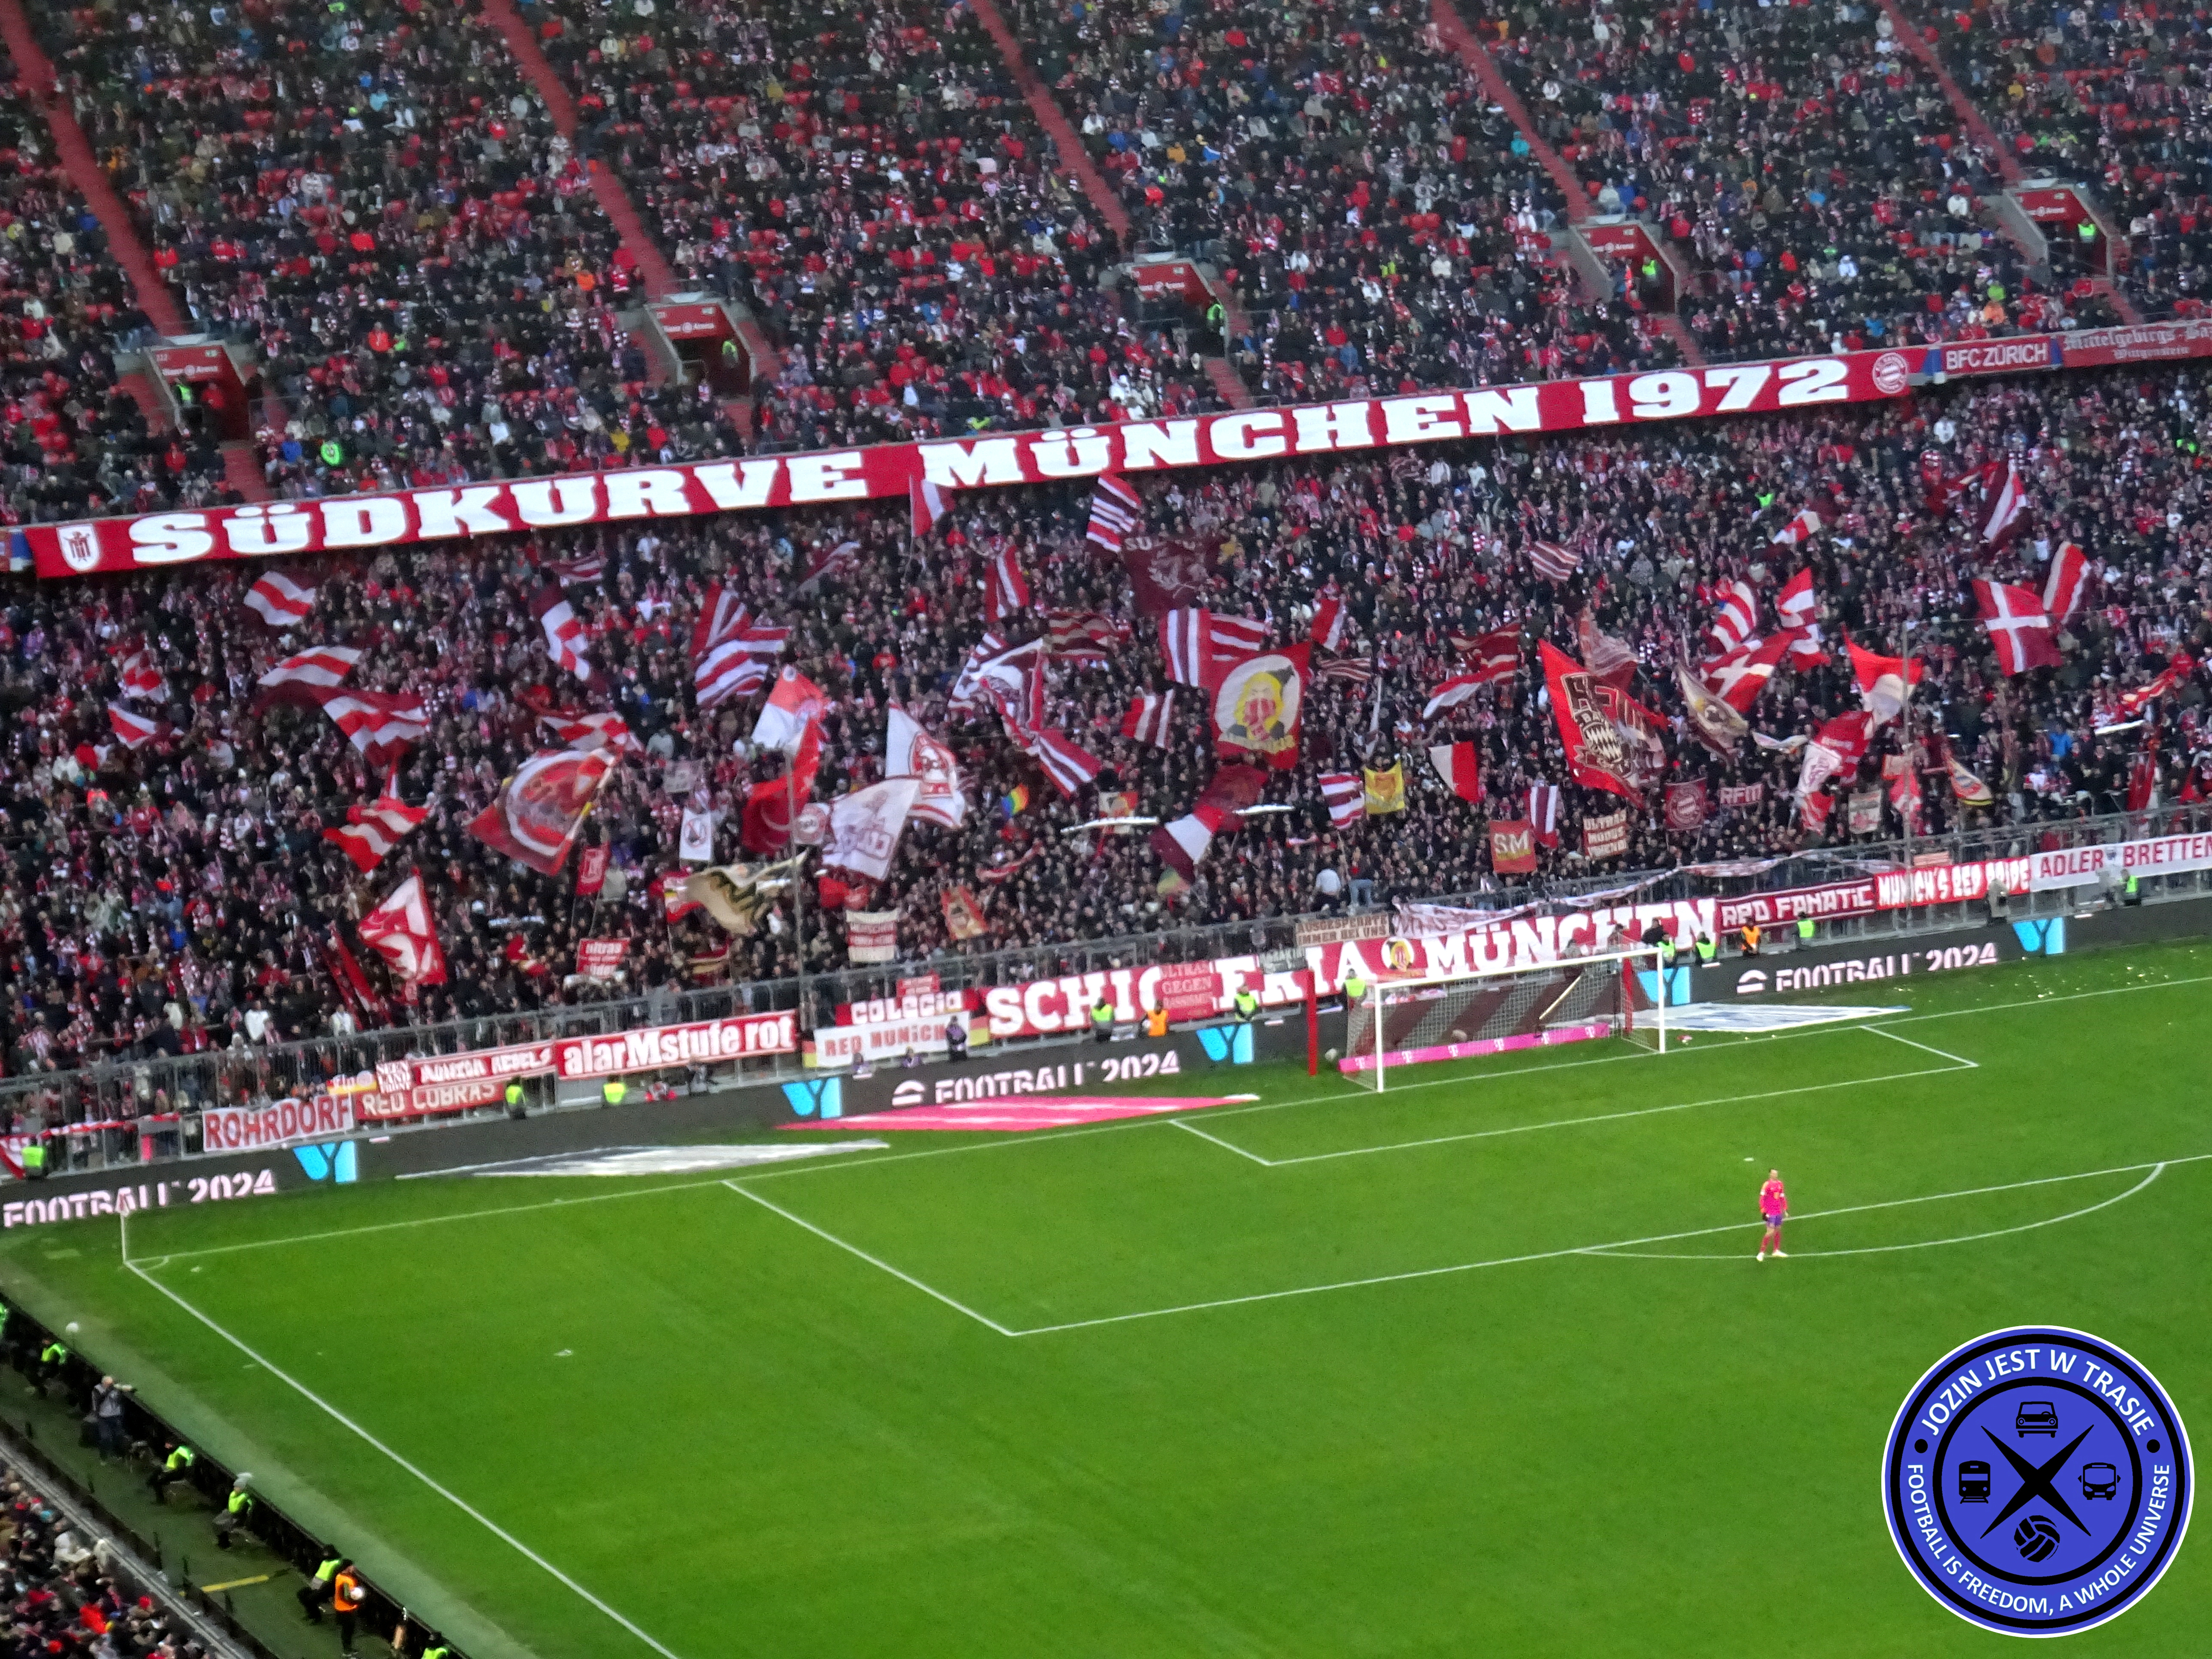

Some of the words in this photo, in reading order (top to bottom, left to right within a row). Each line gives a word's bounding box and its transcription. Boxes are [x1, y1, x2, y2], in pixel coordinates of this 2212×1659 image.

[1946, 348, 1981, 370] BFC
[1983, 342, 2048, 366] ZÜRICH
[129, 451, 868, 563] SÜDKURVE
[919, 386, 1542, 487] MÜNCHEN
[1580, 359, 1849, 424] 1972
[1494, 829, 1529, 854] SM
[2040, 850, 2104, 878] ADLER
[1926, 942, 1997, 972] 2024
[1161, 976, 1211, 995] GEGEN
[745, 1017, 792, 1052] rot
[825, 1036, 862, 1056] RED
[1101, 1051, 1181, 1082] 2024
[363, 1092, 405, 1115] RED
[205, 1095, 352, 1149] ROHRDORF
[189, 1169, 276, 1204] 2024
